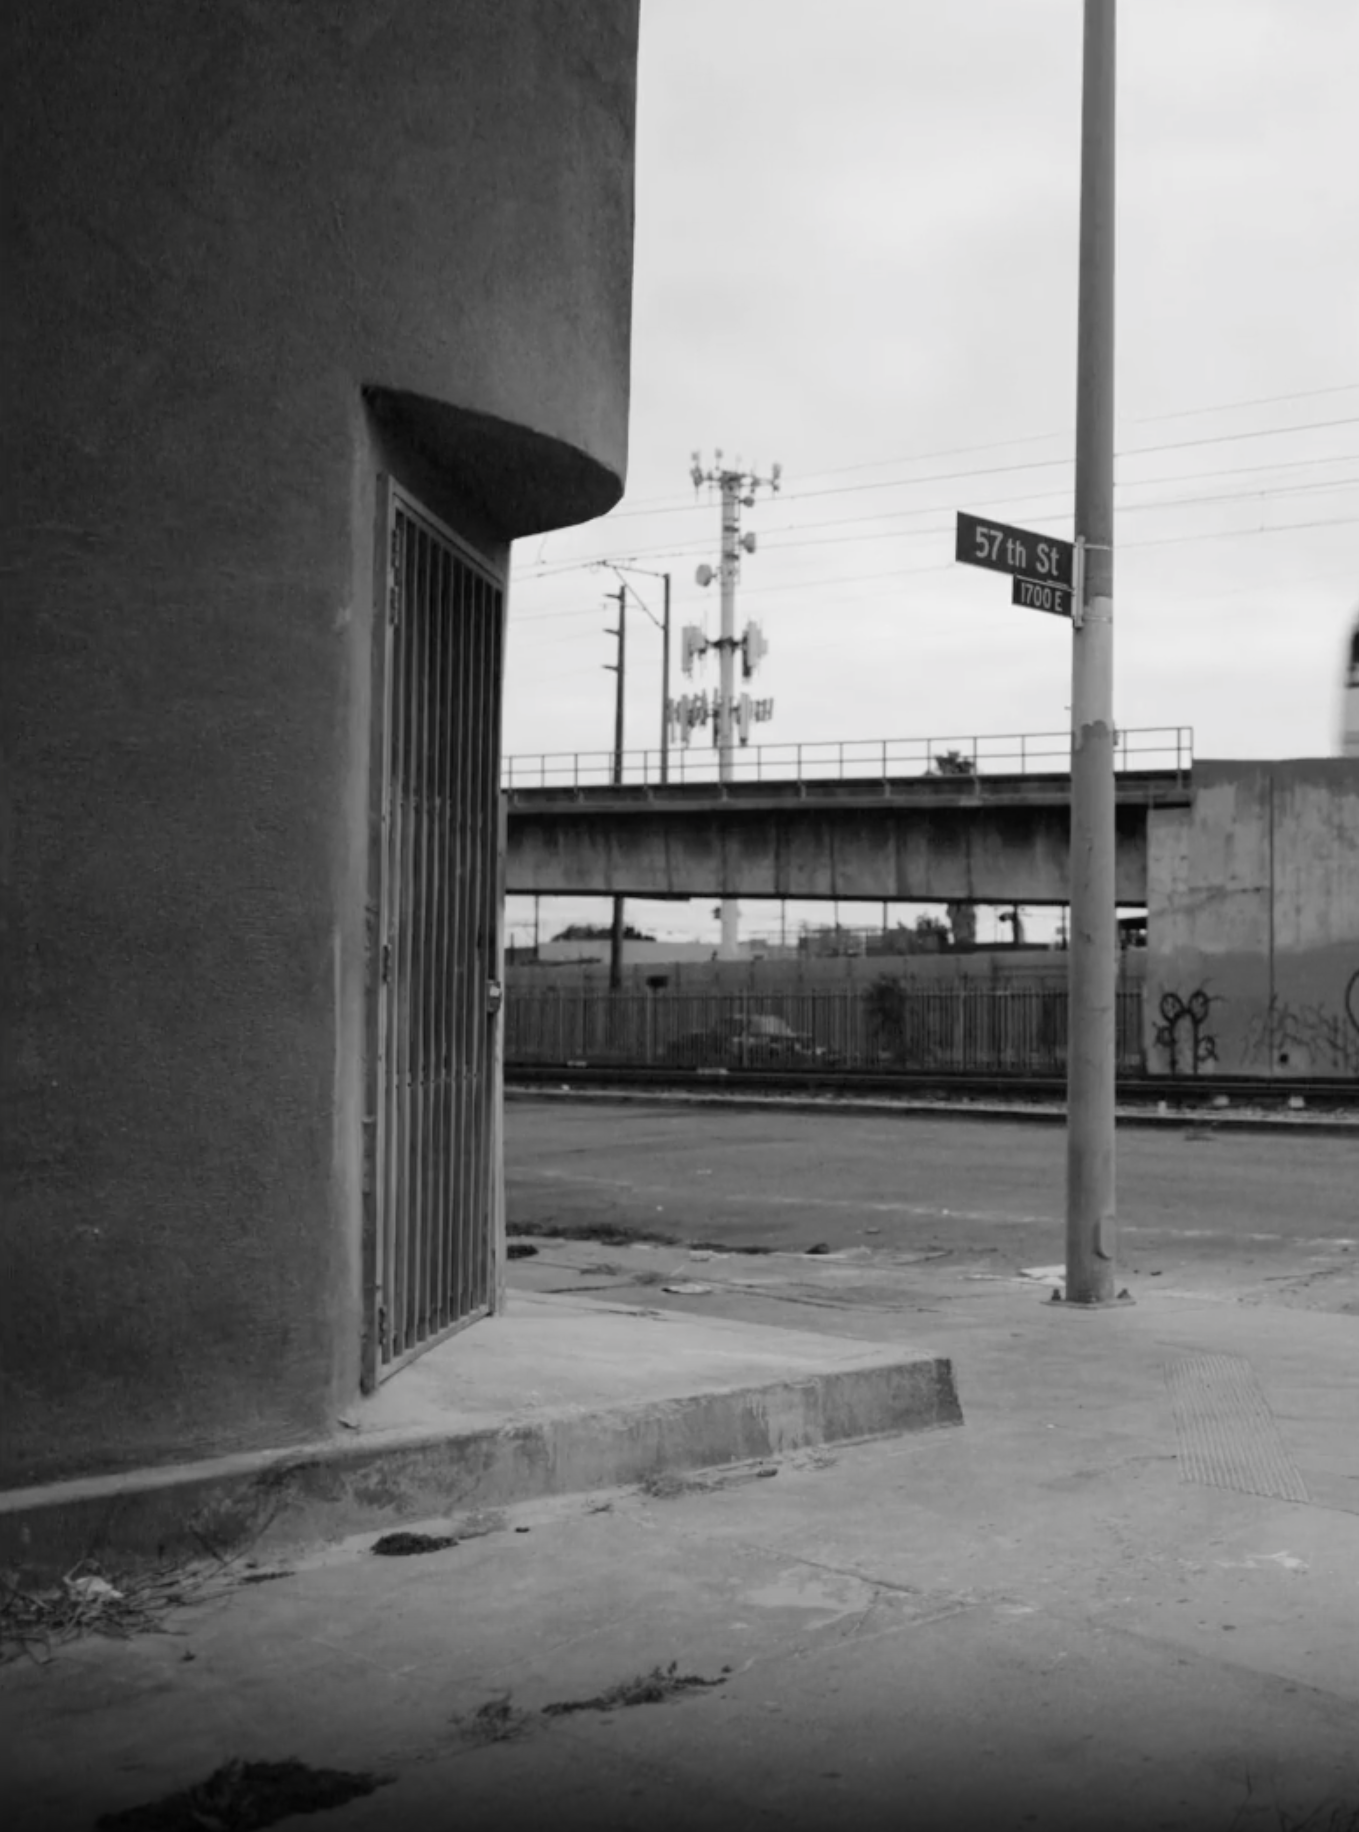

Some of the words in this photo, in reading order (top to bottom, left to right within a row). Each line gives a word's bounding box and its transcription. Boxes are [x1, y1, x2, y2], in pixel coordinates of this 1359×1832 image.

[975, 525, 1027, 569] 57th
[1035, 542, 1060, 577] St
[1020, 581, 1053, 610] 1700
[1054, 590, 1064, 612] E
